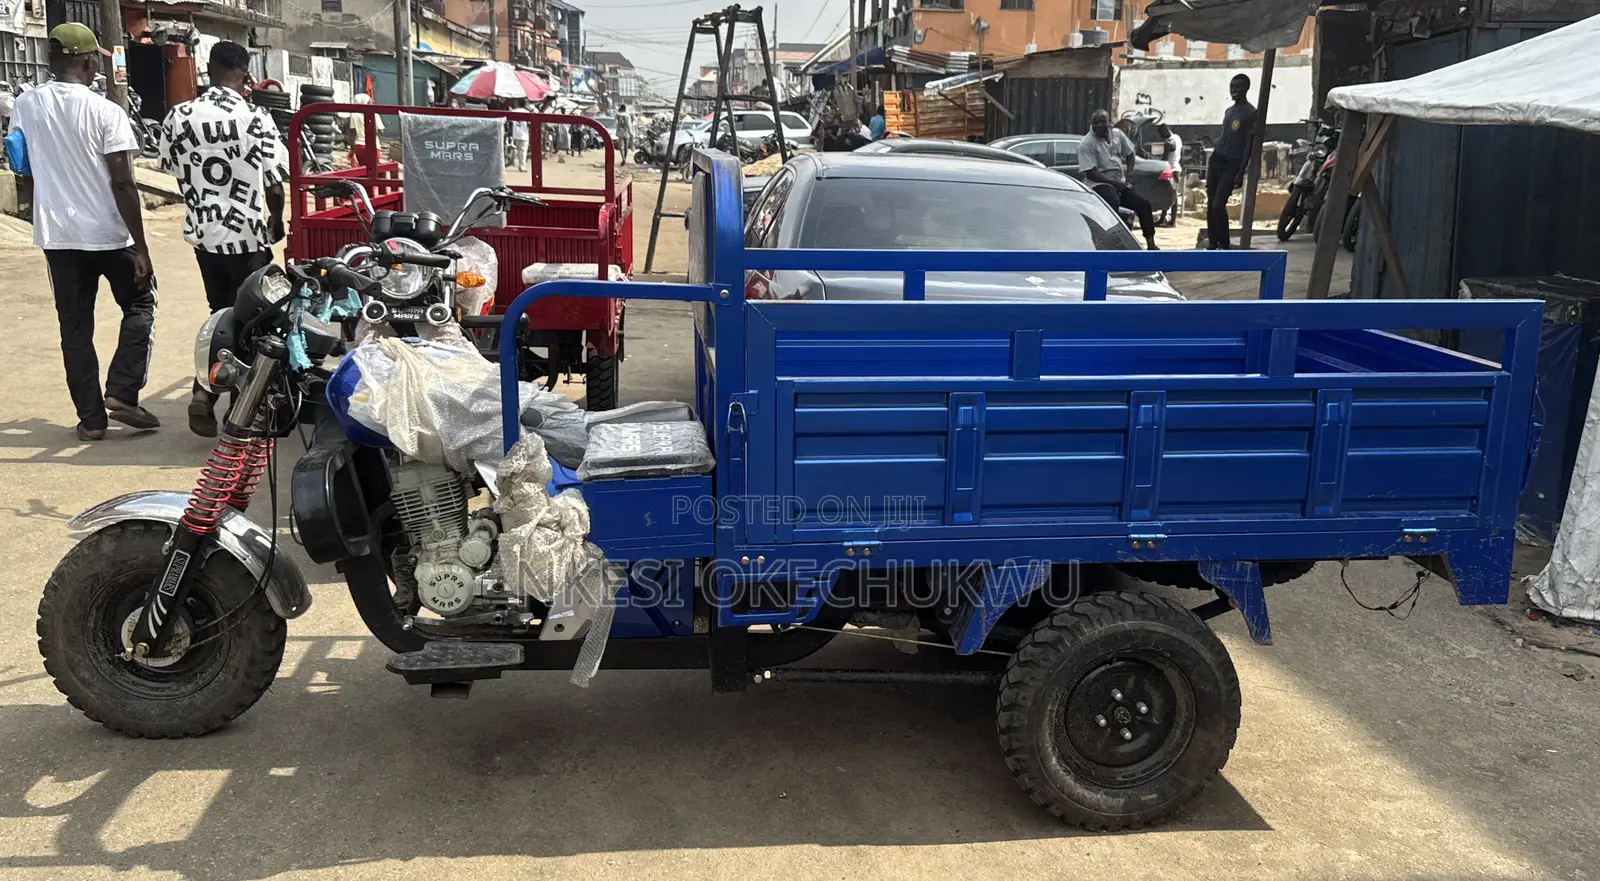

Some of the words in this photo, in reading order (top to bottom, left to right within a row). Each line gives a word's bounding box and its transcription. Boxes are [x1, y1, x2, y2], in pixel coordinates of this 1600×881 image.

[424, 140, 480, 151] SUPRA
[430, 151, 474, 161] MARS
[429, 573, 465, 589] SUPRA
[431, 596, 462, 608] MARS
